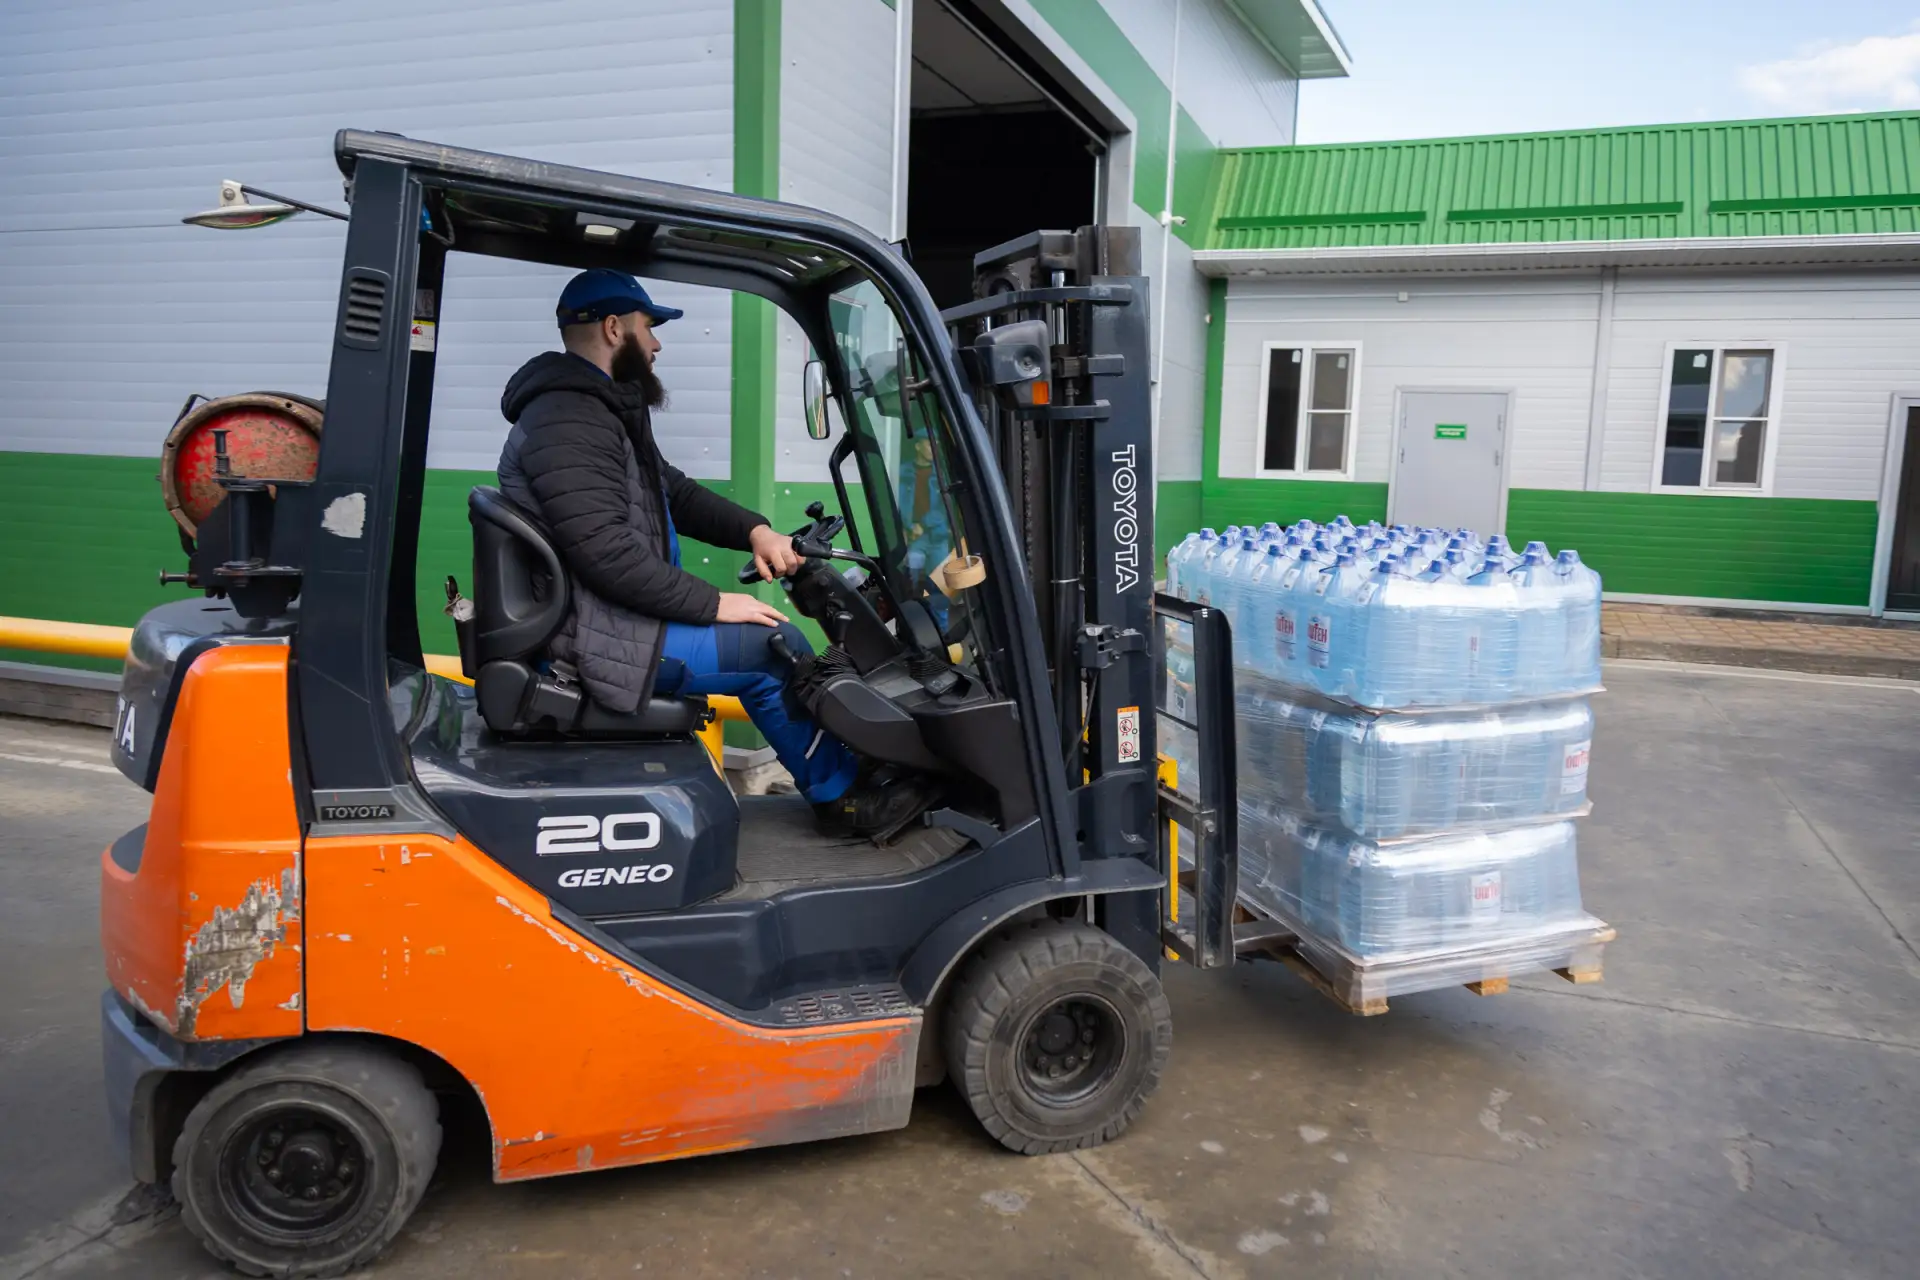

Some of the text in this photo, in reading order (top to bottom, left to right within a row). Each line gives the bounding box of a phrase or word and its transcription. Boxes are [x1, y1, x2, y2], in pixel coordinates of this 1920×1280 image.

[1112, 444, 1139, 594] TOYOTA
[1307, 623, 1328, 643] ШТЕН
[325, 806, 390, 819] TOYOTA
[536, 812, 661, 855] 20
[557, 863, 674, 888] GENEO
